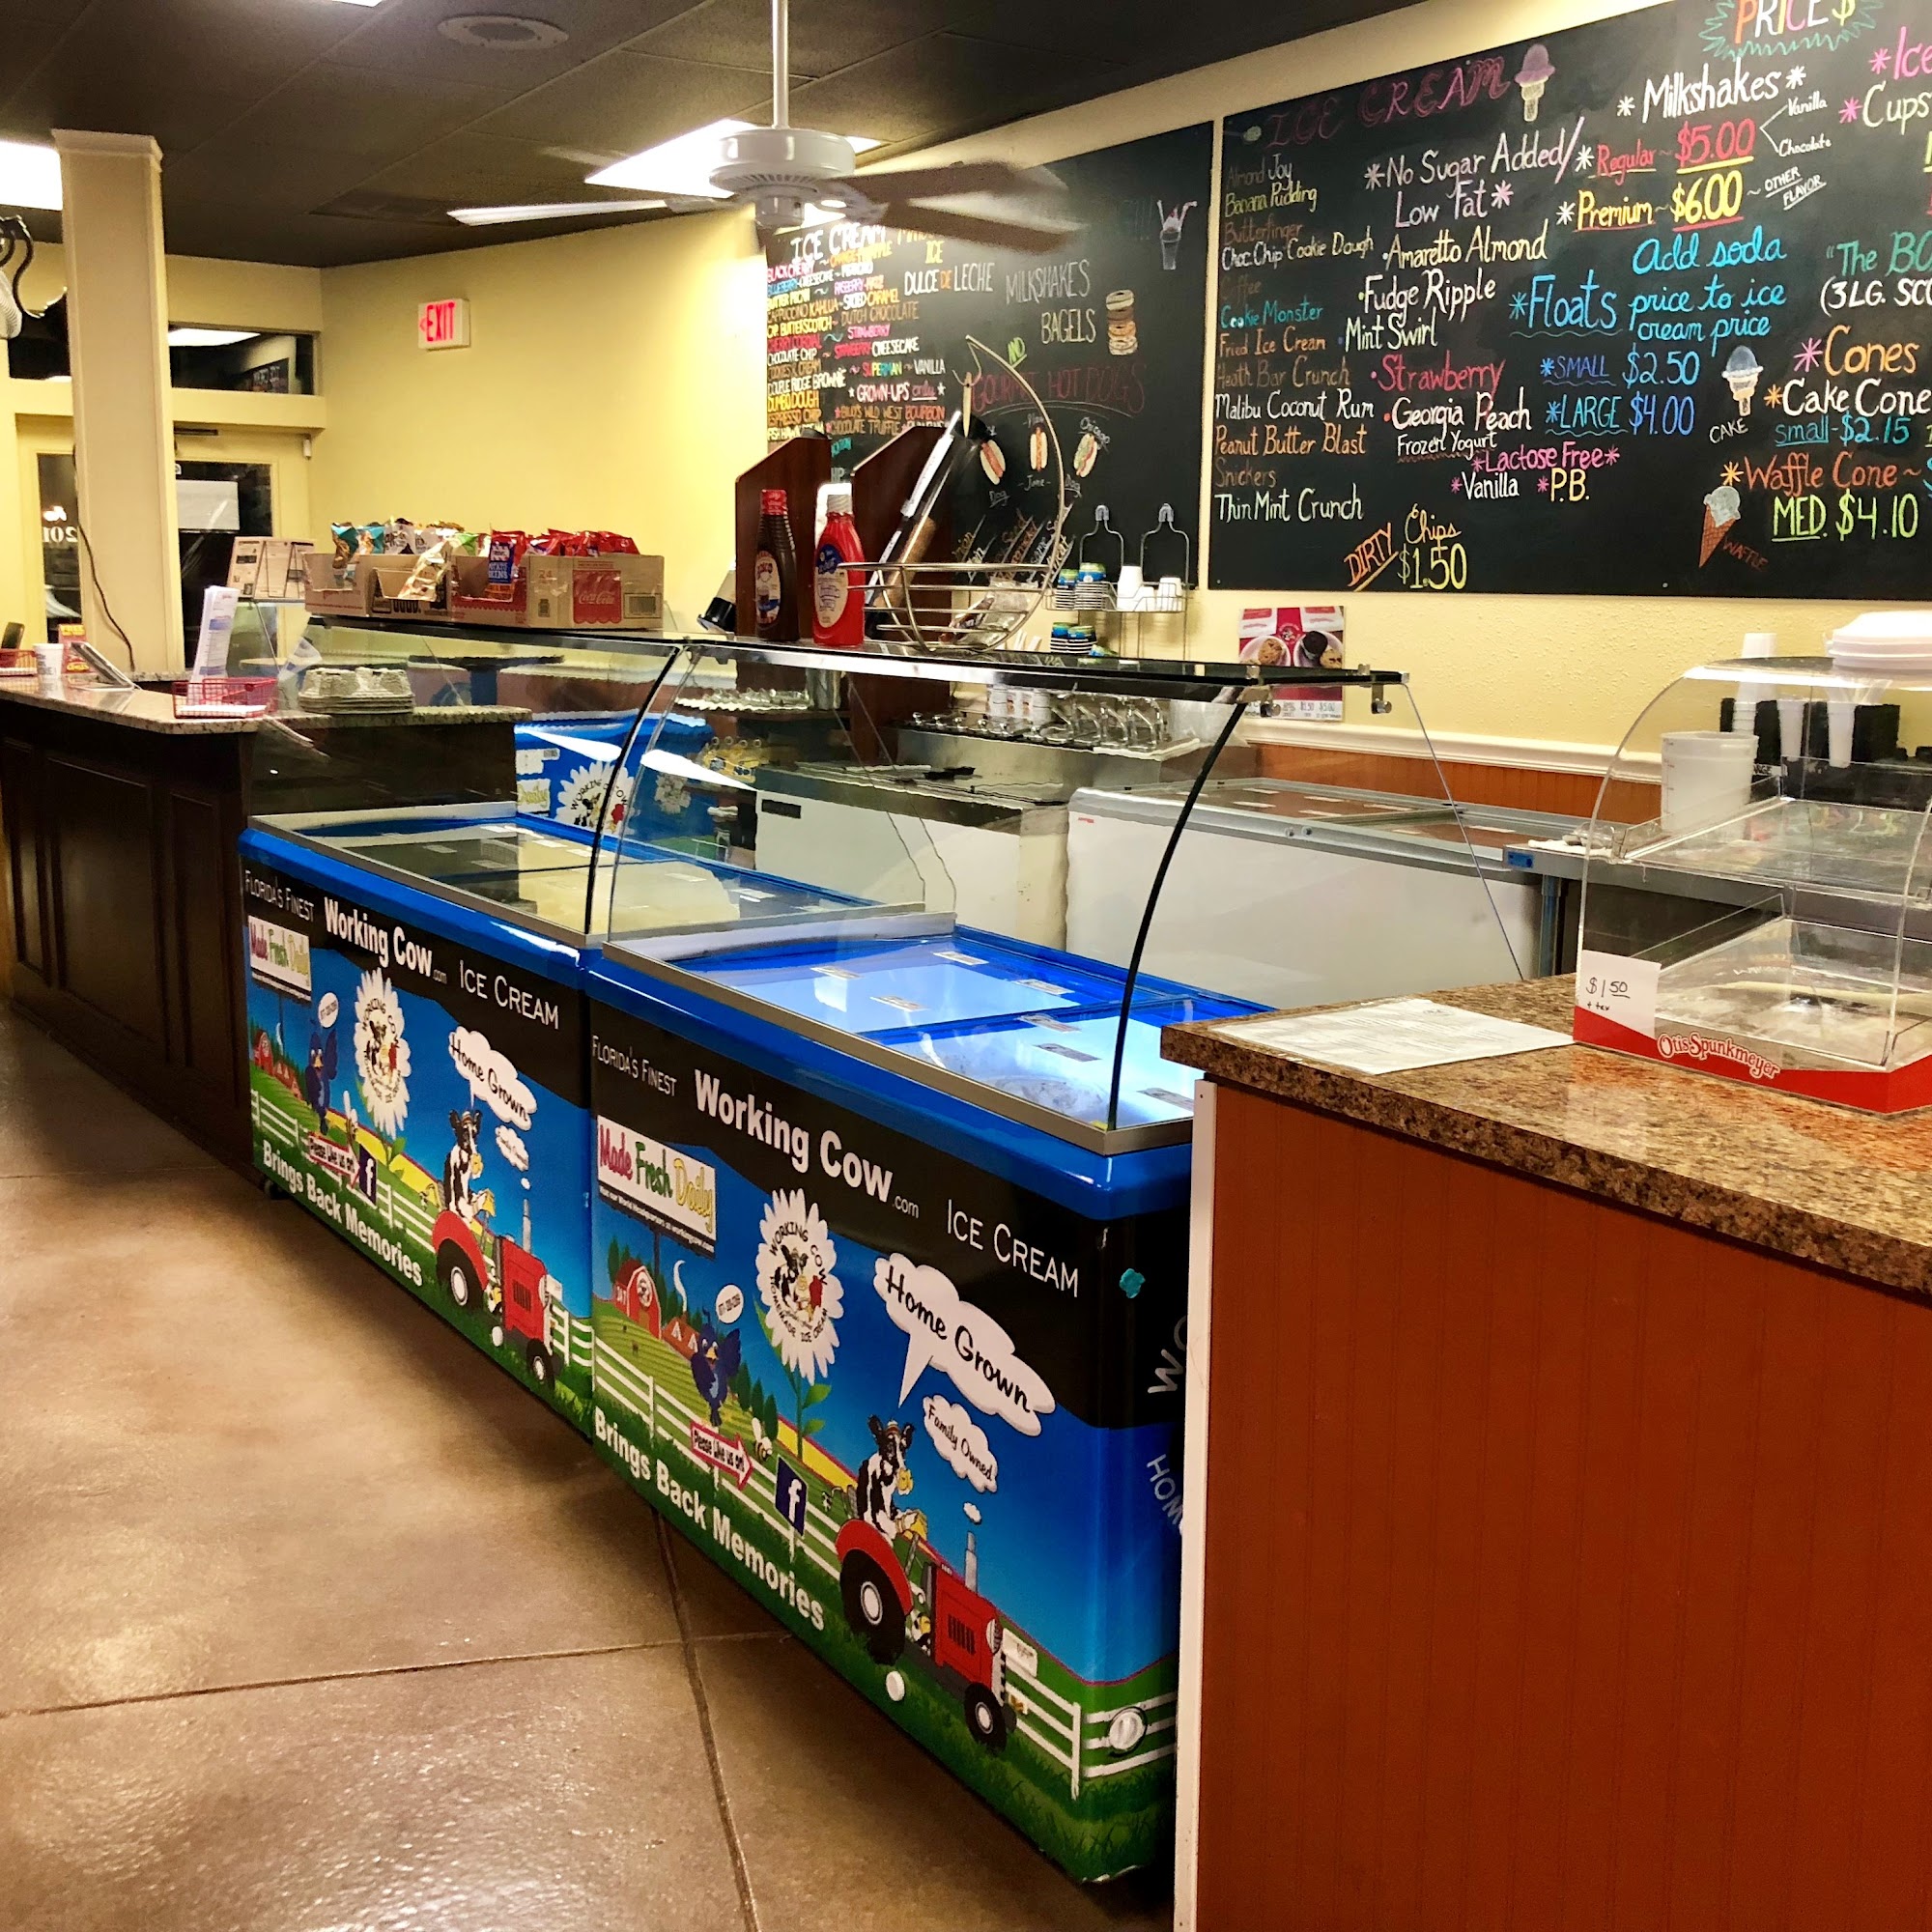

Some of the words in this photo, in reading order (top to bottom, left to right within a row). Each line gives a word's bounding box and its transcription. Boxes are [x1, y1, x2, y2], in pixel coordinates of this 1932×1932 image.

[1267, 97, 1345, 147] ICE
[1357, 56, 1511, 128] CREAM
[1642, 56, 1782, 123] Milkshakes
[1787, 91, 1829, 117] Vanilla
[1862, 80, 1932, 135] Cups
[1598, 139, 1655, 185] Regular
[1675, 119, 1756, 169] $5.00
[1778, 137, 1832, 157] Chocolate
[1268, 153, 1293, 190] Joy
[1386, 156, 1414, 187] No
[1420, 150, 1485, 197] Sugar
[1765, 166, 1803, 190] OTHER
[1225, 193, 1268, 217] Banana
[1270, 183, 1317, 212] Pudding
[1395, 191, 1440, 228] Low
[1452, 181, 1489, 219] Fat
[1577, 190, 1654, 230] Premium
[1671, 170, 1744, 224] $6.00
[790, 230, 823, 262] ICE
[829, 222, 887, 255] CREAM
[1225, 213, 1303, 245] Butterfinger
[1254, 242, 1283, 270] Chip
[1287, 236, 1327, 260] Cookie
[1332, 225, 1374, 259] Dough
[1386, 229, 1461, 270] Amaretto
[1465, 219, 1548, 263] Almond
[1632, 232, 1700, 274] Add
[1707, 226, 1787, 268] soda
[904, 270, 939, 296] DULCE
[940, 270, 952, 289] DE
[953, 263, 995, 292] LECHE
[1006, 259, 1091, 304] MILKSHAKES
[1364, 274, 1420, 325] Fudge
[1424, 268, 1496, 323] Ripple
[1528, 270, 1618, 328] Floats
[1629, 286, 1695, 331] price
[1698, 273, 1736, 310] to
[1741, 279, 1787, 307] ice
[426, 301, 456, 342] EXIT
[1041, 308, 1096, 344] BAGELS
[1220, 304, 1261, 328] Cookie
[1263, 296, 1323, 325] Monster
[1345, 317, 1383, 352] Mint
[1388, 308, 1438, 351] Swirl
[1637, 320, 1706, 342] cream
[1710, 309, 1773, 357] price
[1219, 333, 1249, 358] Fried
[1255, 328, 1276, 355] Ice
[1283, 326, 1327, 351] Cream
[1824, 325, 1919, 377] Cones
[913, 358, 946, 375] VANILLA
[1257, 360, 1287, 386] Bar
[1292, 354, 1350, 387] Crunch
[1378, 349, 1506, 415] Strawberry
[1554, 355, 1609, 379] SMALL
[1622, 342, 1701, 389] $2.50
[857, 382, 910, 403] GROWN-UPS
[1214, 392, 1262, 420] Malibu
[1266, 389, 1326, 421] Coconut
[1336, 388, 1375, 419] Rum
[1391, 397, 1464, 440] Georgia
[1474, 386, 1532, 431] Peach
[1559, 393, 1622, 429] LARGE
[1629, 390, 1695, 435] $4.00
[1783, 377, 1850, 415] Cake
[1855, 378, 1932, 416] Cone
[1214, 424, 1259, 455] Peanut
[1263, 424, 1315, 455] Butter
[1321, 422, 1367, 455] Blast
[1397, 434, 1445, 456] Frozen
[1450, 430, 1497, 460] Yogurt
[1709, 417, 1748, 444] CAKE
[1776, 414, 1829, 442] small
[1839, 411, 1911, 446] $2.15
[1214, 459, 1277, 488] Snickers
[1485, 444, 1558, 472] Lactose
[1561, 441, 1605, 469] Free
[1744, 452, 1824, 497] Waffle
[1833, 451, 1898, 489] Cone
[1214, 493, 1253, 523] Thin
[1255, 488, 1291, 522] Mint
[1298, 483, 1364, 522] Crunch
[1461, 471, 1520, 499] Vanilla
[1405, 504, 1462, 556] Chips
[1773, 494, 1828, 538] MED.
[1835, 487, 1918, 542] $4.10
[1344, 523, 1394, 587] DIRTY
[1397, 542, 1467, 590] $1.50
[1722, 537, 1769, 569] WAFFLE
[285, 888, 315, 922] FINEST
[324, 896, 388, 968] Working
[393, 925, 433, 978] Cow
[459, 960, 487, 999] ICE
[494, 975, 559, 1030] CREAM
[592, 1036, 639, 1079] FLORIDA'S
[641, 1059, 677, 1098] FINEST
[1657, 1033, 1690, 1058] Otis
[1690, 1031, 1781, 1080] Spunkmeyer
[451, 1035, 485, 1083] Home
[488, 1068, 531, 1123] Grown
[695, 1069, 810, 1174] Working
[820, 1129, 893, 1203] Cow
[599, 1125, 633, 1180] Made
[635, 1141, 673, 1198] Fresh
[673, 1157, 714, 1235] Daily
[263, 1140, 304, 1193] Brings
[306, 1173, 342, 1224] Back
[345, 1203, 423, 1287] Memories
[769, 1221, 809, 1256] WORKING
[810, 1244, 828, 1286] COW
[947, 1198, 983, 1251] ICE
[994, 1223, 1079, 1298] CREAM
[885, 1264, 948, 1341] Home
[954, 1325, 1031, 1413] Grown
[928, 1404, 958, 1451] Family
[961, 1437, 993, 1481] Owned
[594, 1407, 651, 1482] Brings
[656, 1462, 707, 1531] Back
[713, 1512, 825, 1633] Memories
